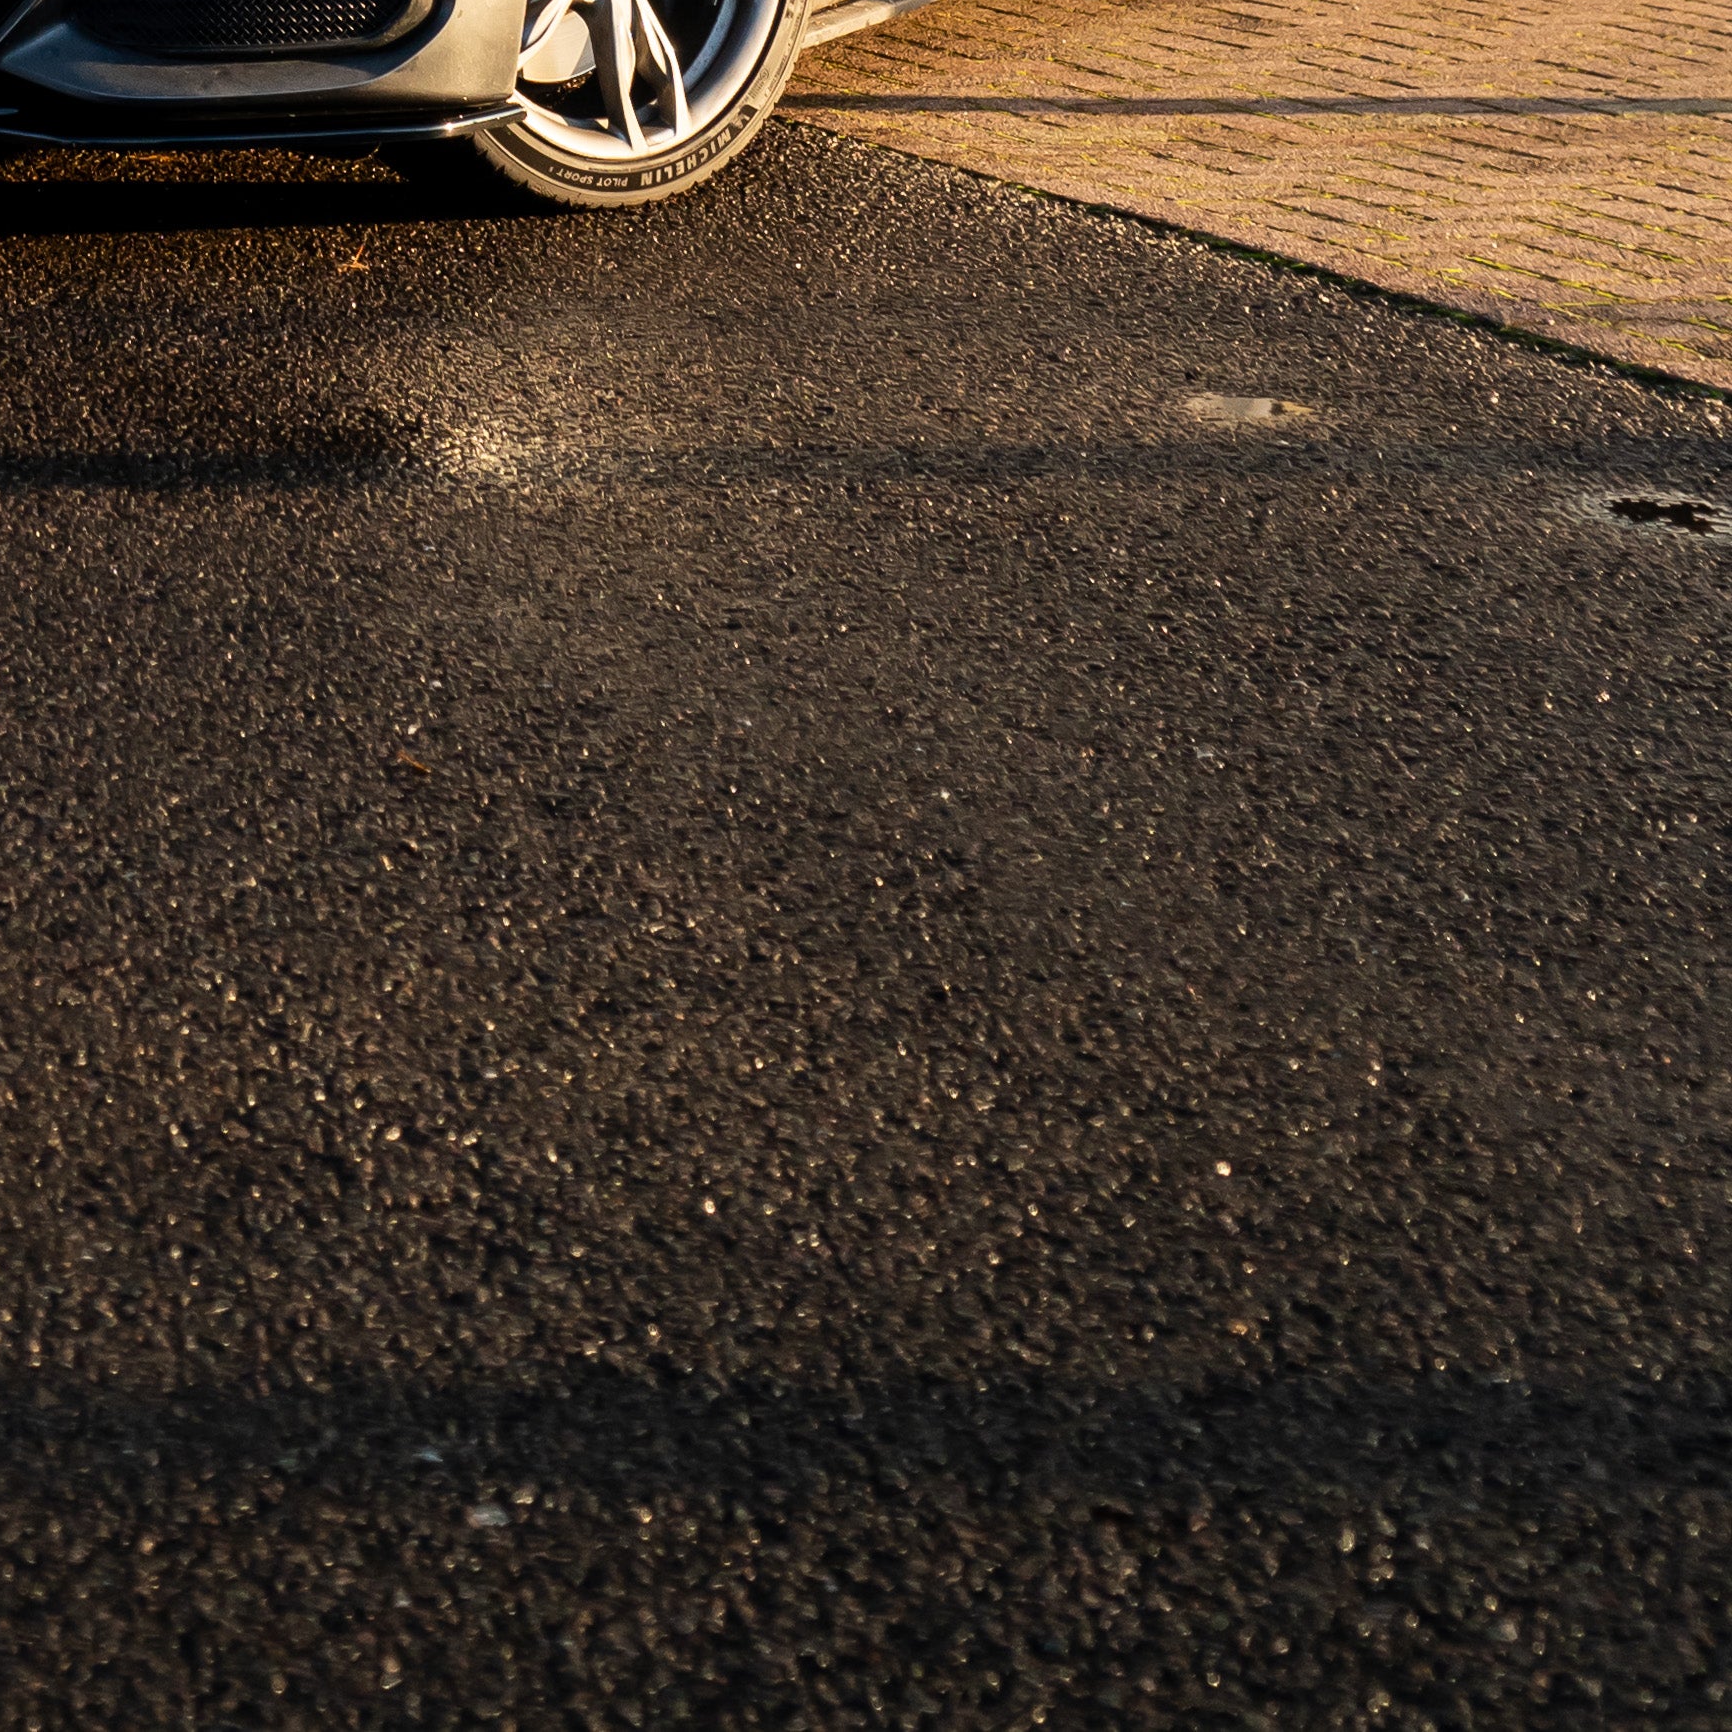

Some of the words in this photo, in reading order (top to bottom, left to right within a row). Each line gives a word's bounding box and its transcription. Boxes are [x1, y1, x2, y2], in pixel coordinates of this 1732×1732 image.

[639, 127, 732, 186] MICHELIN
[556, 168, 594, 185] SPORT
[596, 176, 629, 187] PILOT
